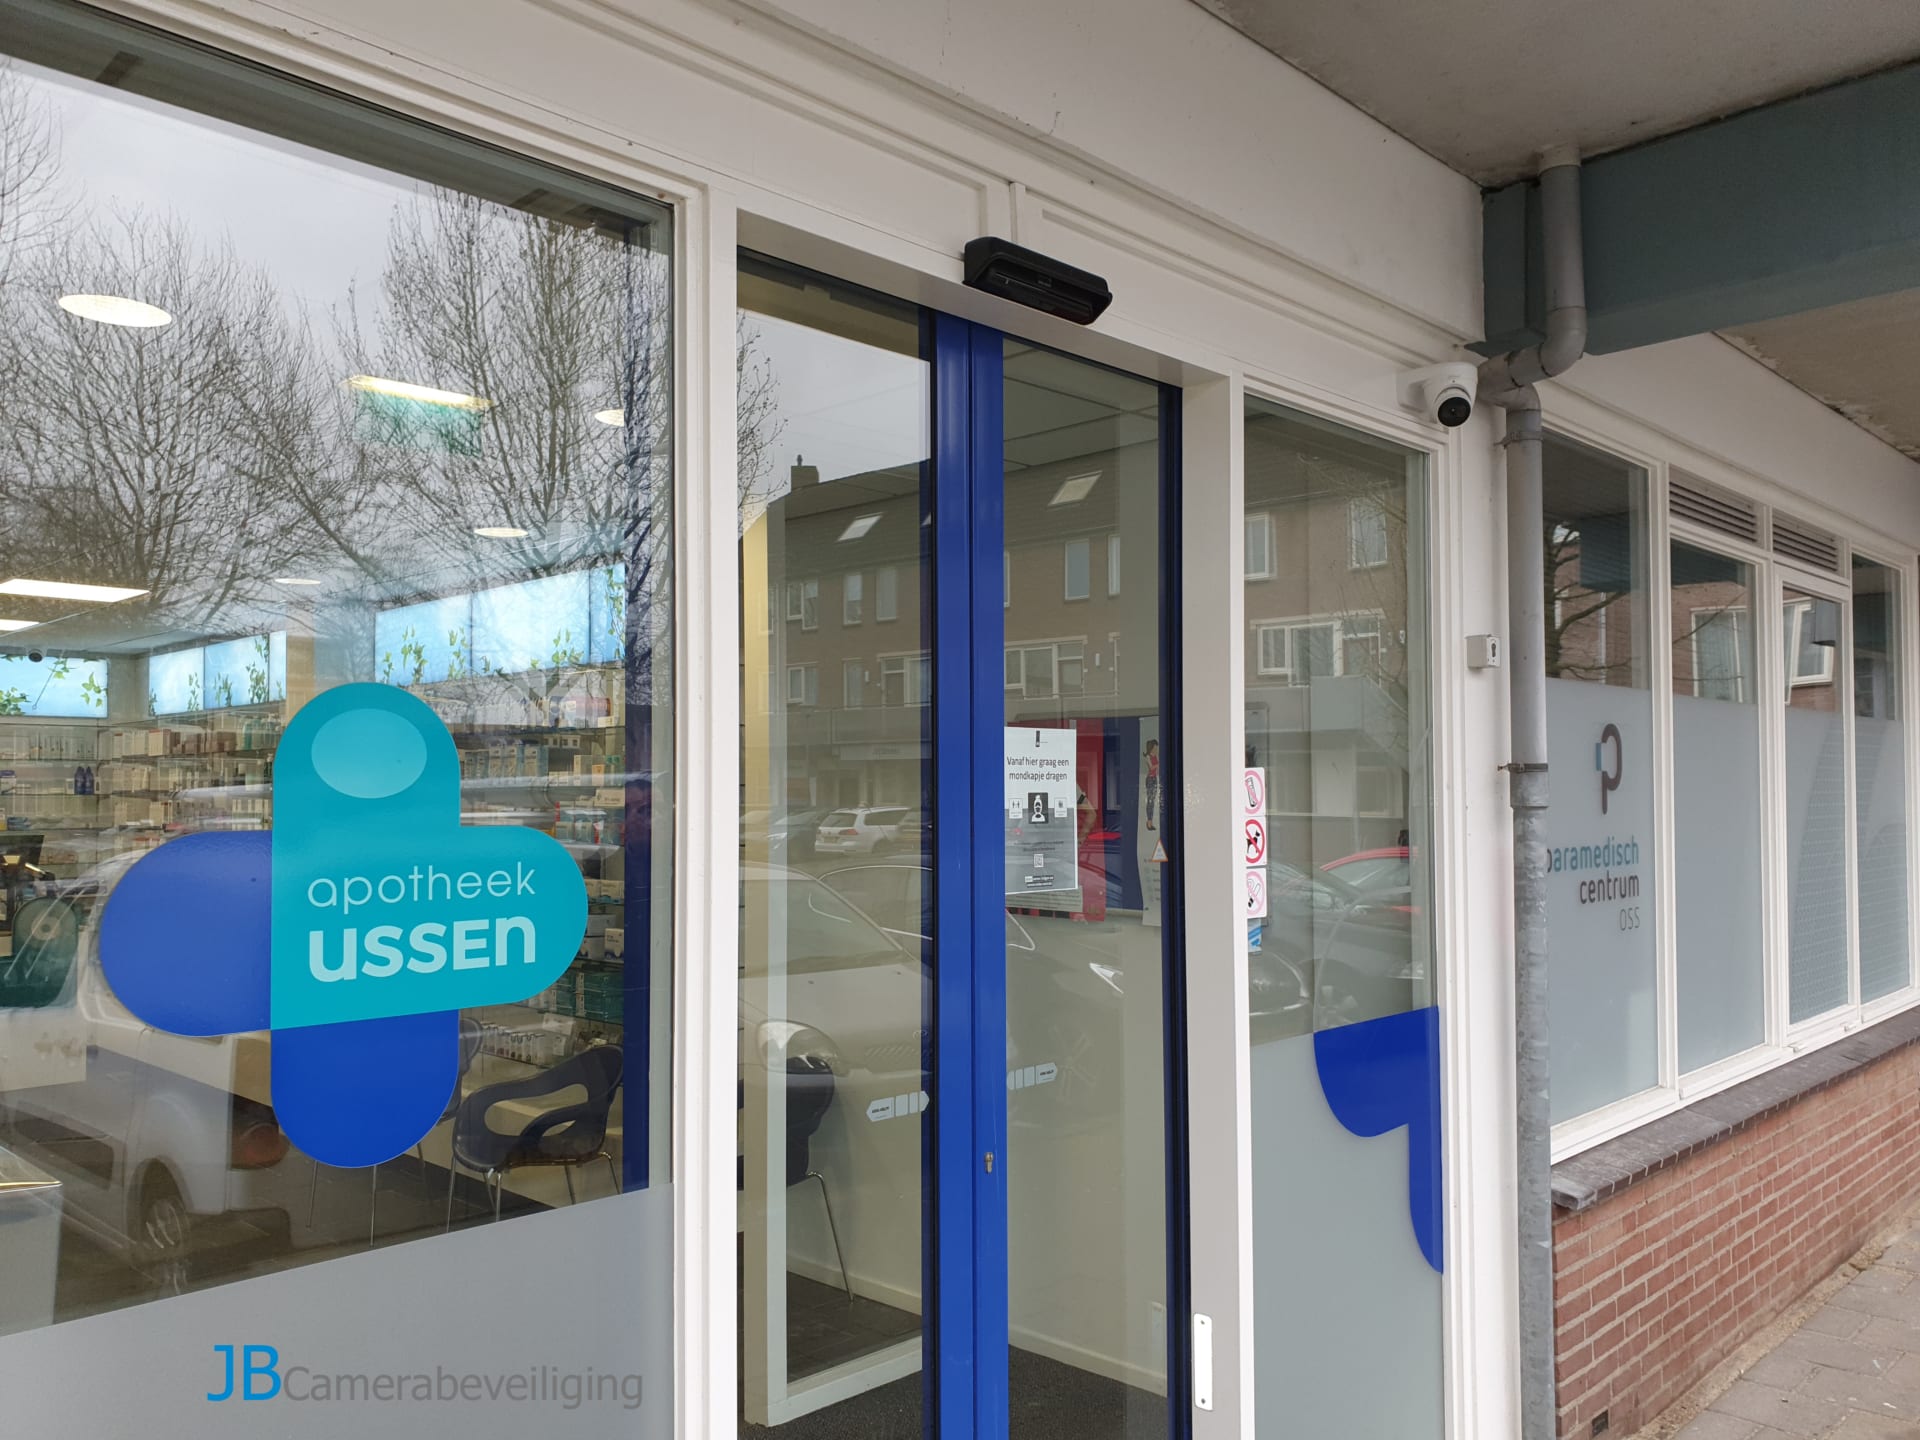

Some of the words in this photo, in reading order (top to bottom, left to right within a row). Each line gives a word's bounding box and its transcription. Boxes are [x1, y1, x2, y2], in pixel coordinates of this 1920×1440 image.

[1006, 756, 1025, 766] Vanaf
[1025, 756, 1038, 766] hier
[1039, 759, 1057, 768] graag
[1009, 771, 1045, 782] mondkapje
[1045, 771, 1068, 782] dragen
[307, 861, 536, 915] apotheek
[1580, 870, 1640, 904] centrum
